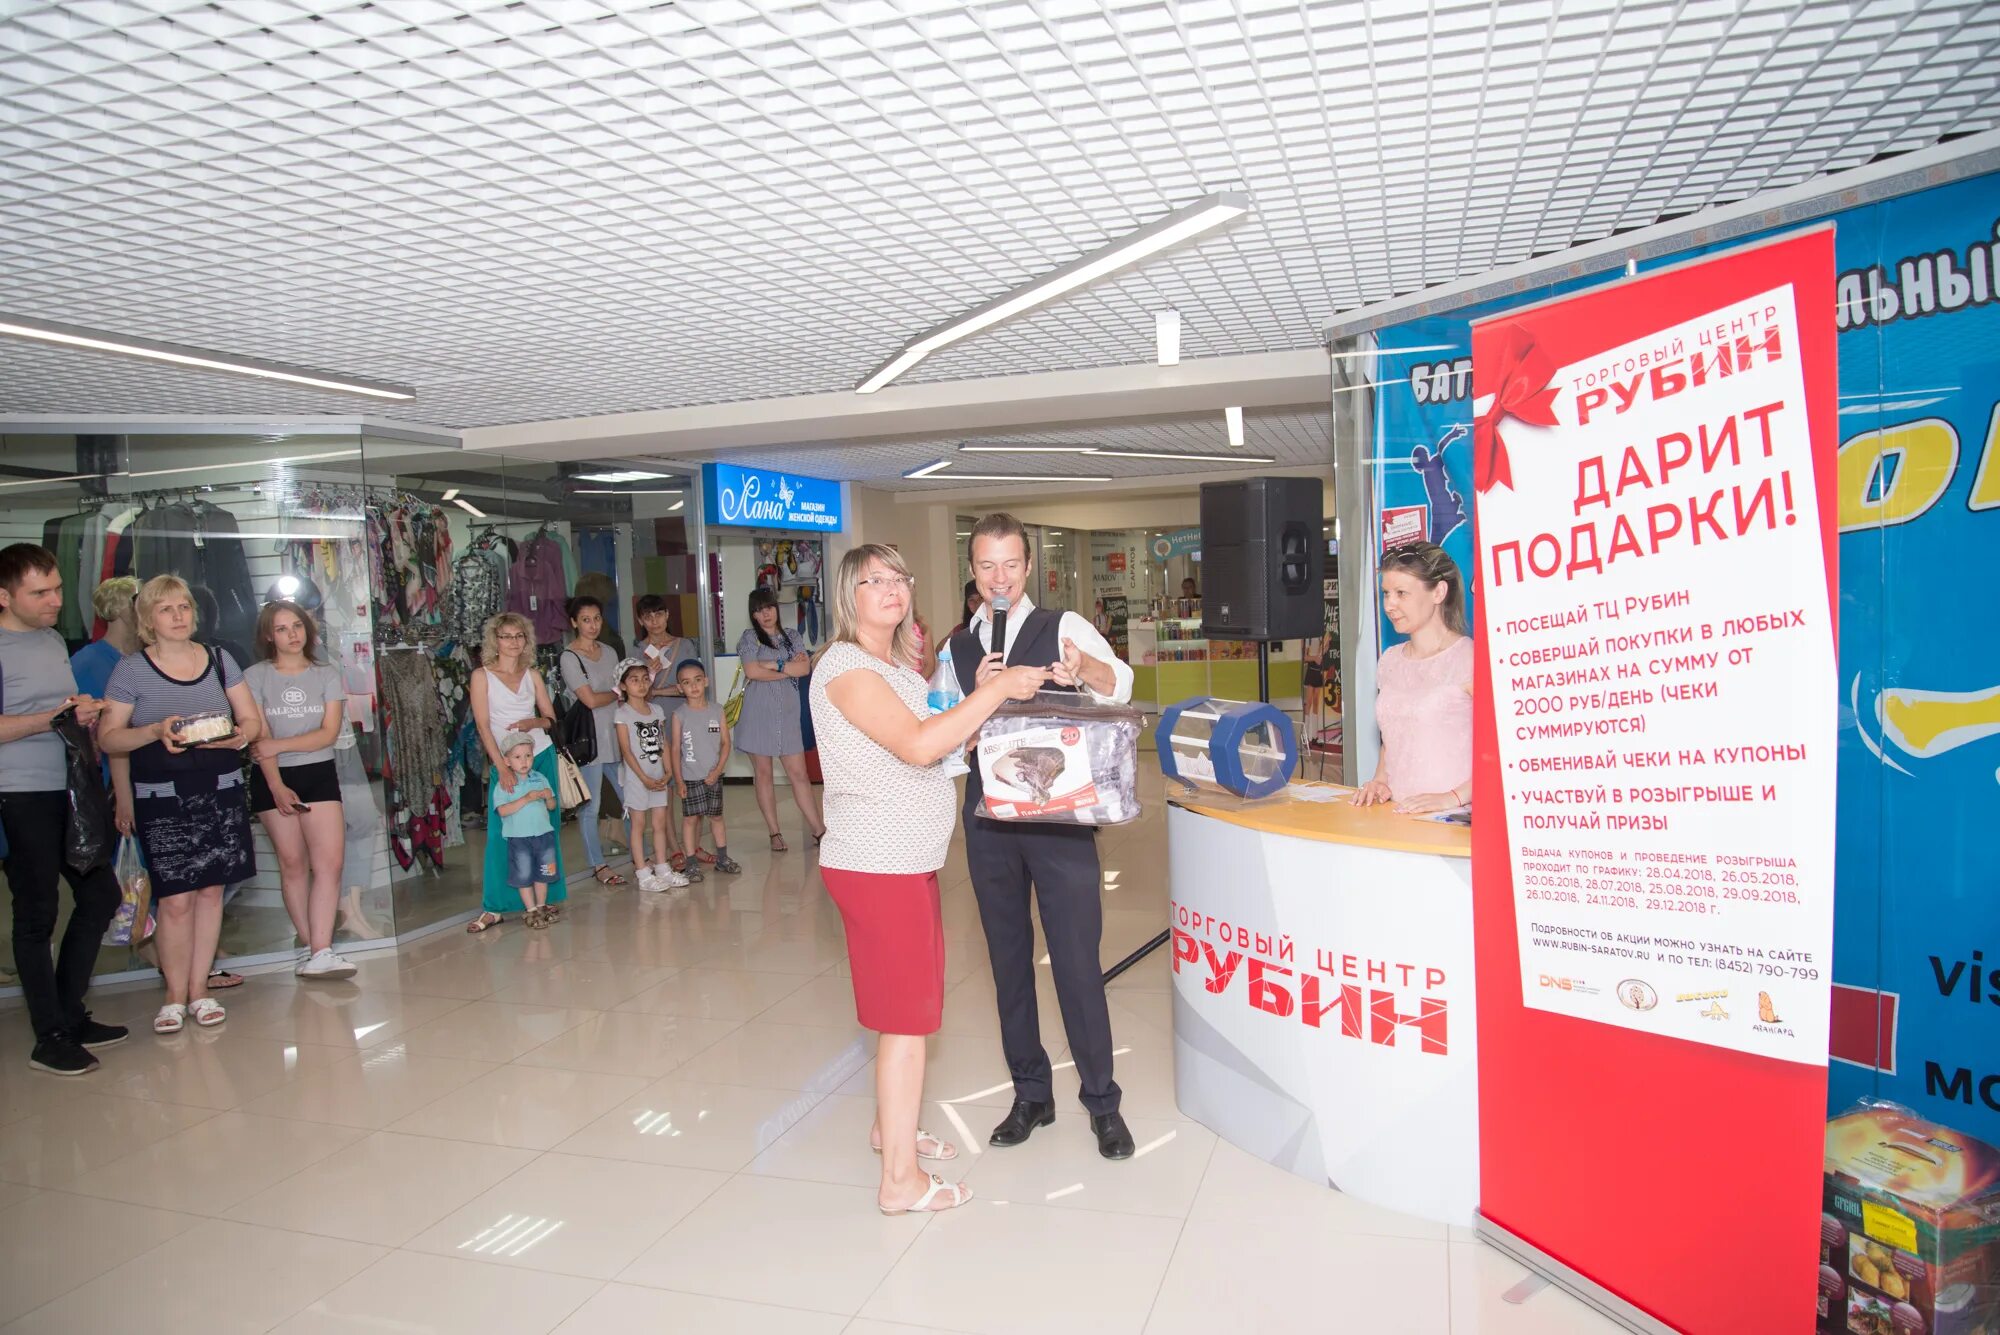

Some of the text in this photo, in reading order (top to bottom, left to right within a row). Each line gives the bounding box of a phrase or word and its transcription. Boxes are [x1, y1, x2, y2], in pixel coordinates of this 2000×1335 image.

[1835, 220, 2000, 328] ЛЬНЫ
[1573, 306, 1776, 391] ТОРГОВЫЙ ЦЕНТР
[1576, 325, 1782, 425] РУБИН
[1573, 400, 1784, 516] ДАРИТ
[722, 474, 785, 520] Лана
[801, 502, 825, 512] МАГАЗИН
[789, 512, 837, 526] ЖЕНСКОЙ ОДЕЖДЫ
[1492, 470, 1797, 587] ПОДАРКИ!
[1506, 591, 1689, 634] ПОСЕЩАЙ ТЦ РУБИН
[1510, 610, 1805, 666] СОВЕРШАЙ ПОКУПКИ В ЛЮБЫХ
[1512, 648, 1752, 690] МАГАЗИНАХ НА СУММУ ОТ
[1515, 682, 1717, 716] 2000 РУБ/ДЕНЬ (ЧЕКИ
[1516, 716, 1645, 740] СУММИРУЮТСЯ)
[1519, 744, 1806, 772] ОБМЕНИВАЙ ЧЕКИ НА КУПОНЫ
[1522, 785, 1776, 804] УЧАСТВУЙ В РОЗЫГРЫШЕ И
[1524, 811, 1667, 830] ПОЛУЧАЙ ПРИЗЫ
[1522, 847, 1797, 868] ВЫДАЧА КУПОНОВ И ПРОВЕДЕНИЕ РОЗЫГРЫША
[1523, 862, 1799, 887] ПРОХОДИТ ПО ГРАФИКУ: 28.04.2018, 26.05.2018,
[1525, 875, 1801, 905] 30.06.2018, 28.07.2018, 25.08.2018, 29.09.2018,
[1527, 890, 1580, 904] 26.10.2018,
[1586, 894, 1638, 909] 24.11.2018,
[1646, 898, 1706, 914] 29.12.2018
[1171, 900, 1445, 989] ТОРГОВЫЙ ЦЕНТР
[1531, 922, 1813, 963] ПОДРОБНОСТИ ОБ АКЦИИ МОЖНО УЗНАТЬ НА САЙТЕ
[1533, 938, 1818, 981] WWW.RUBIN-SARATOV.RU И ПО ТЕЛ: (8452) 790-799
[1171, 926, 1448, 1056] РУБИН
[1539, 975, 1572, 991] DNS
